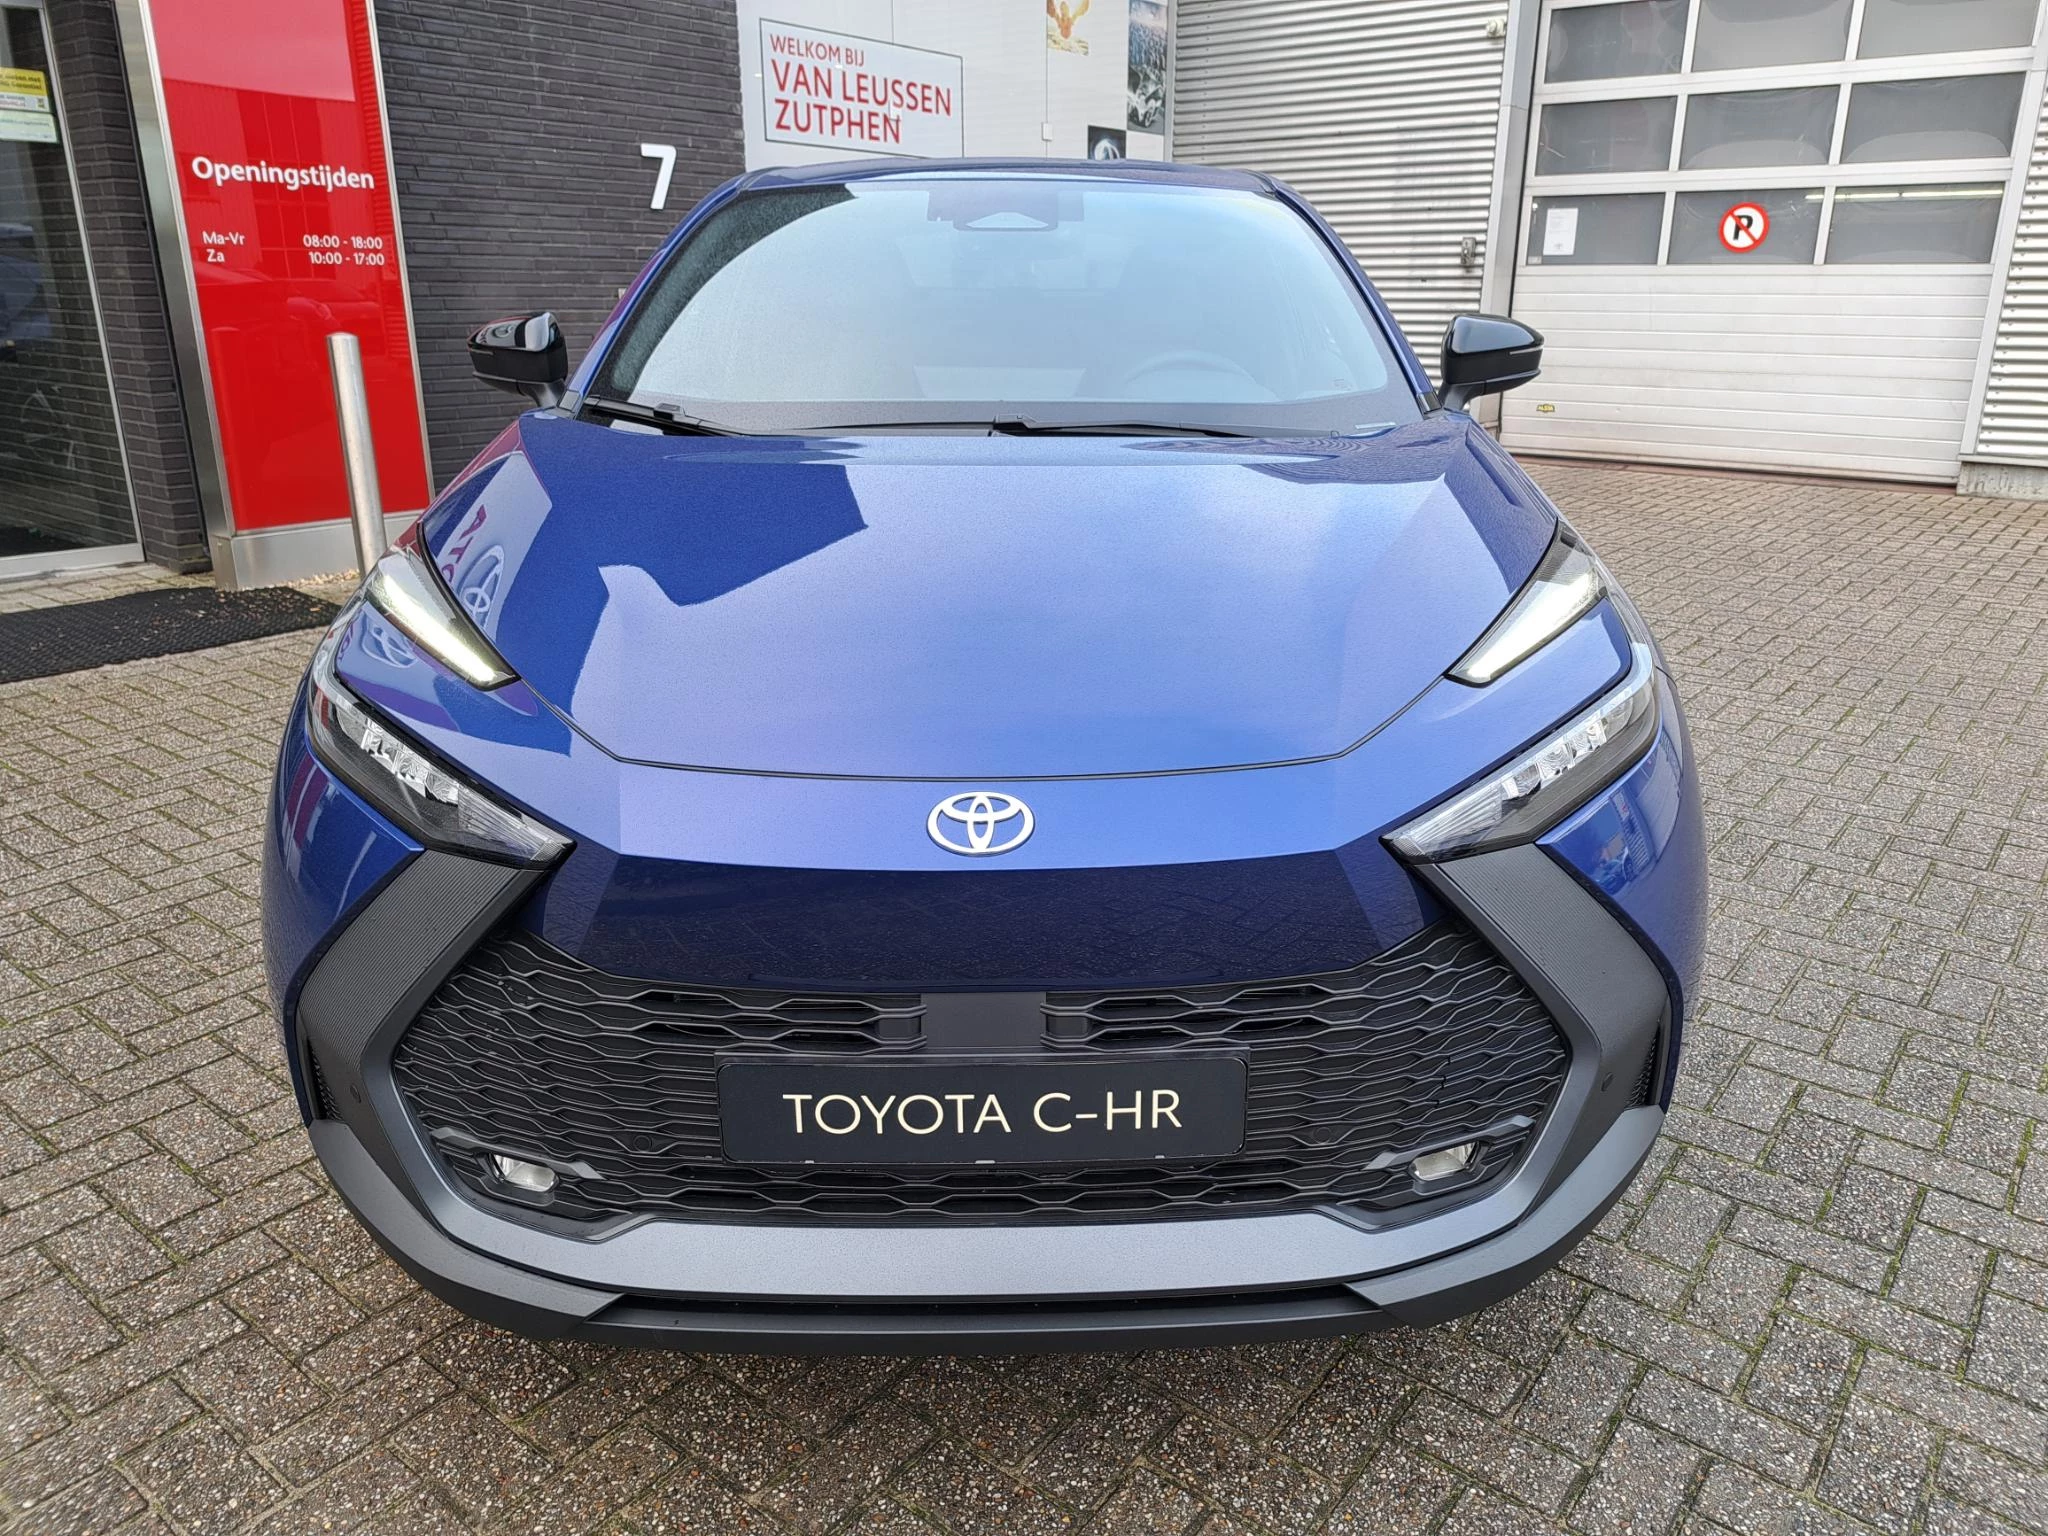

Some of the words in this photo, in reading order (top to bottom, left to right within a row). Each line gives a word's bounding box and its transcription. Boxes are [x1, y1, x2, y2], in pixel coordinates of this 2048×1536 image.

[769, 33, 841, 64] WELKOM
[845, 47, 865, 67] BIJ
[771, 58, 832, 99] VAN
[842, 70, 951, 117] LEUSSEN
[774, 97, 901, 144] ZUTPHEN
[191, 156, 375, 192] Openingstijden
[639, 143, 677, 210] 7
[202, 231, 246, 246] Ma-Vr
[303, 234, 340, 248] 08:00
[351, 236, 383, 250] 18:00
[206, 248, 225, 263] Za
[308, 251, 343, 265] 10:00
[353, 253, 385, 266] 17:00
[782, 1093, 1012, 1135] TOYOTA
[1033, 1088, 1183, 1133] C-HR
